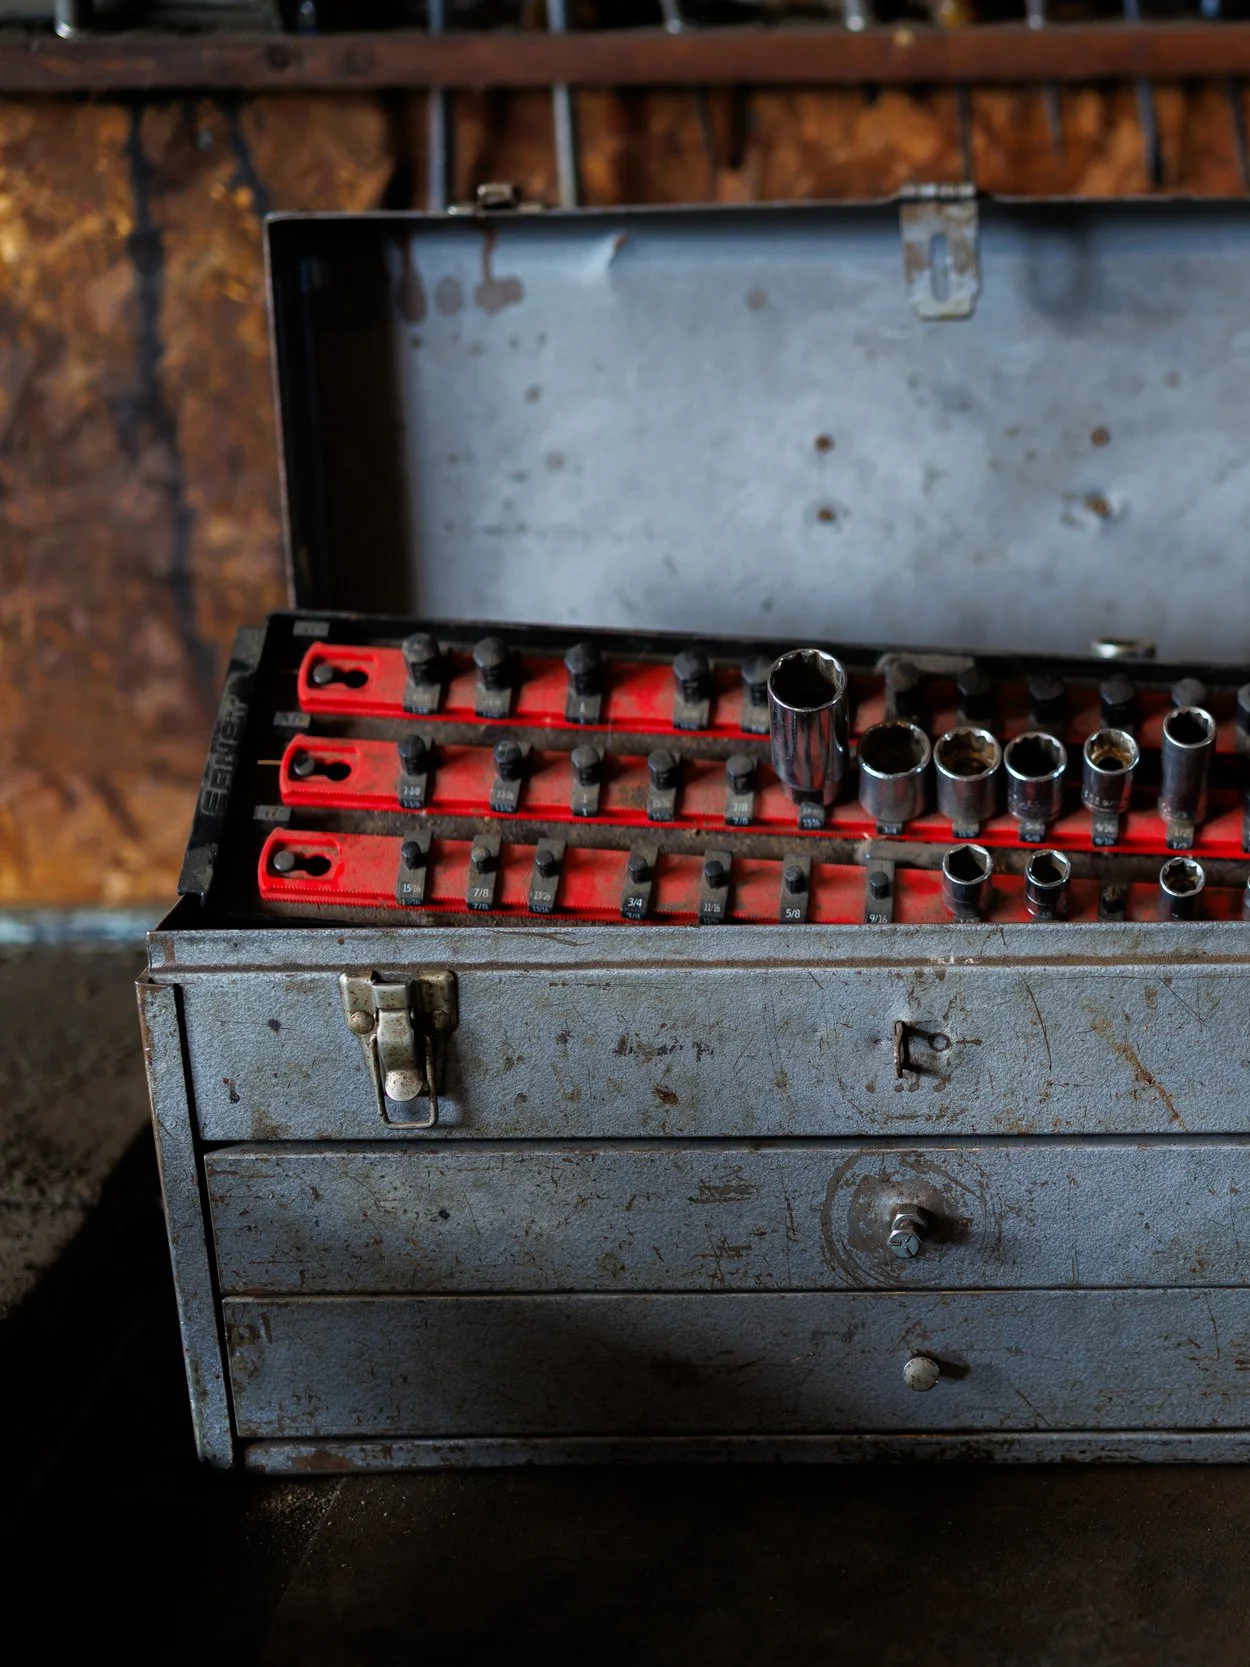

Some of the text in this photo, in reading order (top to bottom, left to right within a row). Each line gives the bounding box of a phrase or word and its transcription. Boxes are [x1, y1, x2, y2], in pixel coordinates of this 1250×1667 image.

[474, 887, 489, 898] 7/8
[627, 897, 643, 907] 3/4
[785, 908, 801, 918] 5/8
[869, 913, 888, 923] 9/16
